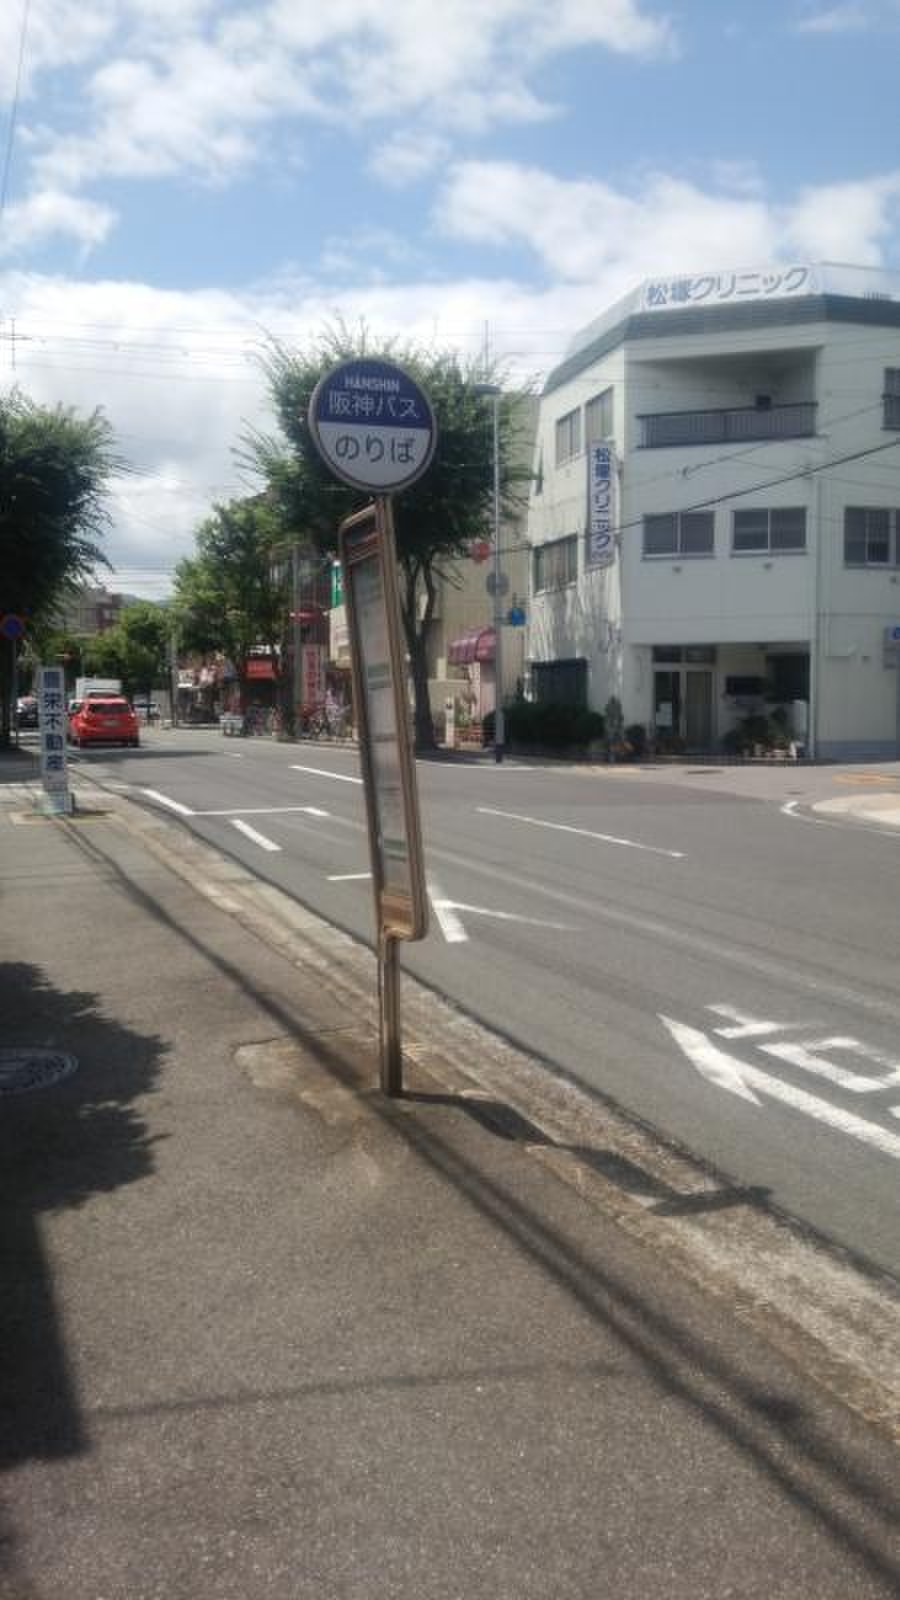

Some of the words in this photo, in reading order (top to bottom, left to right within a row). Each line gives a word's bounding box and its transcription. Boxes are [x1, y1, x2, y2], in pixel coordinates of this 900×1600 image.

[344, 376, 400, 392] HANSHIN
[329, 390, 418, 417] 阪神バス
[336, 434, 416, 463] のりば
